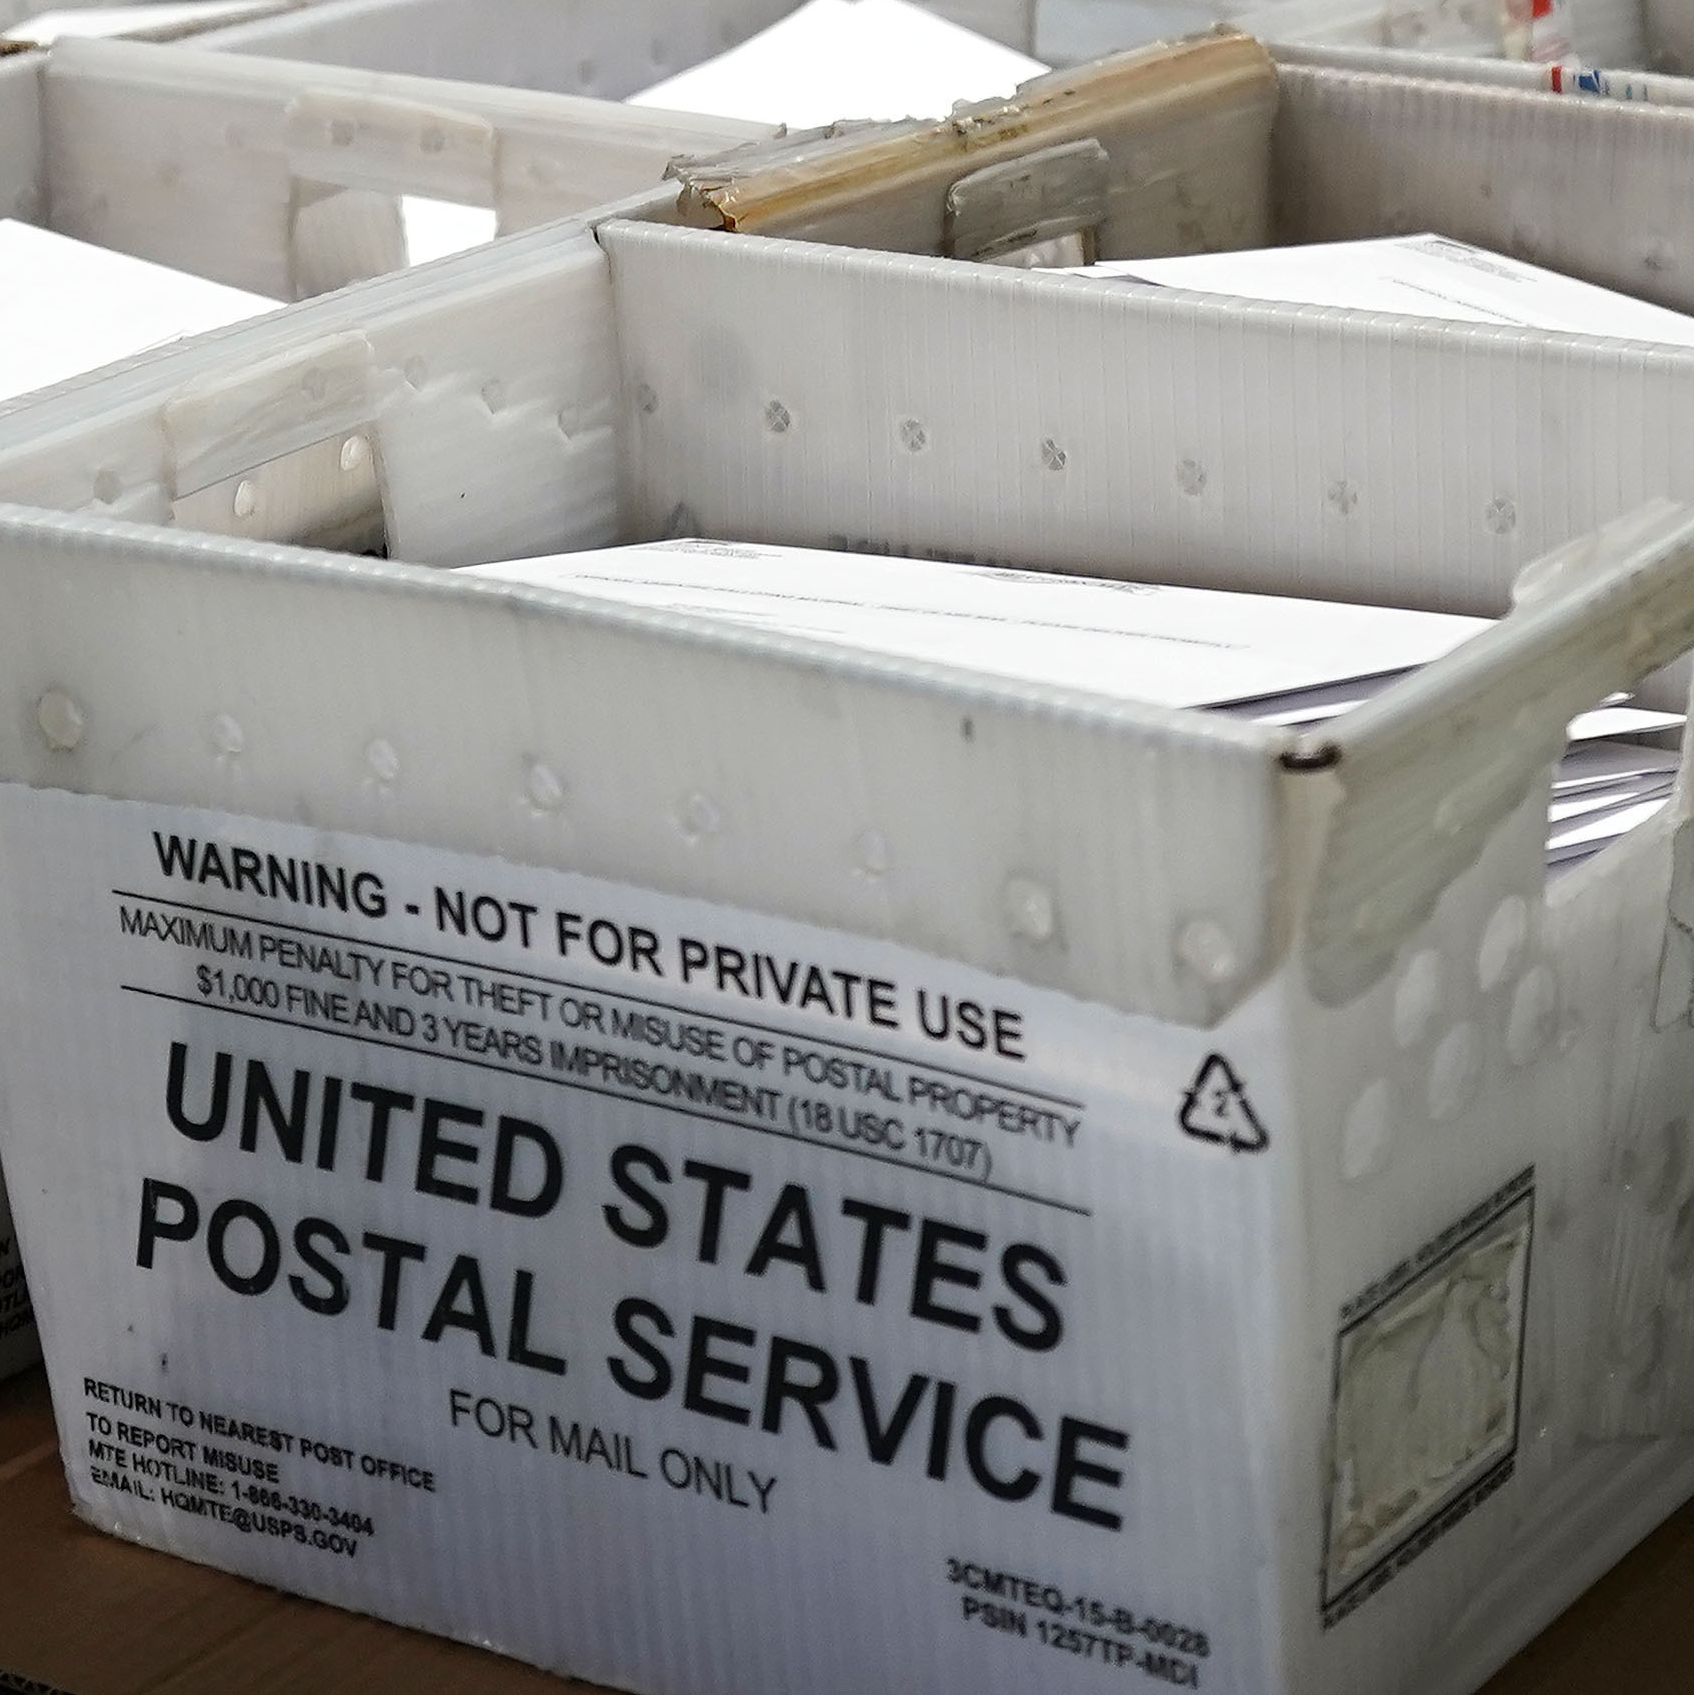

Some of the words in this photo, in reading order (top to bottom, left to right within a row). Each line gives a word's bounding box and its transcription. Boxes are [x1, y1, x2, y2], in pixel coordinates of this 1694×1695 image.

[120, 906, 252, 960] MAXIMUM
[259, 934, 386, 987] PENALTY
[392, 962, 454, 1002] FOR
[457, 975, 553, 1021] THEFT
[558, 996, 605, 1035] OR
[610, 1008, 727, 1061] MISUSE
[732, 1035, 775, 1069] OF
[782, 1046, 899, 1104] POSTAL
[907, 1075, 1081, 1149] PROPERTY
[153, 831, 387, 919] WARNING
[433, 886, 537, 948] NOT
[555, 911, 663, 977] FOR
[679, 938, 899, 1029] PRIVATE
[915, 988, 1027, 1061] USE
[196, 963, 280, 1009] $1,000
[285, 985, 349, 1024] FINE
[353, 996, 415, 1037] AND
[422, 1012, 439, 1043] 3
[441, 1019, 542, 1066] YEARS
[550, 1039, 786, 1121] IMPRISONMENT
[786, 1097, 833, 1136] (18
[838, 1107, 905, 1151] USC
[912, 1125, 993, 1182] 1707)
[166, 1041, 564, 1218] UNITED
[602, 1144, 1068, 1352] STATES
[84, 1377, 162, 1419] RETURN
[166, 1402, 195, 1427] TO
[199, 1410, 296, 1454] NEAREST
[299, 1437, 356, 1471] POST
[360, 1454, 437, 1492] OFFICE
[136, 1177, 567, 1376] POSTAL
[607, 1297, 1131, 1532] SERVICE
[86, 1411, 112, 1436] TO
[116, 1420, 197, 1462] REPORT
[202, 1445, 281, 1484] MISUSE
[88, 1439, 128, 1468] MTE
[132, 1450, 225, 1496] HOTLINE:
[90, 1465, 156, 1503] EMAIL:
[159, 1486, 358, 1558] HQMTE@USPS.GOV
[450, 1389, 538, 1449] FOR
[550, 1413, 648, 1480] MAIL
[660, 1447, 778, 1515] ONLY
